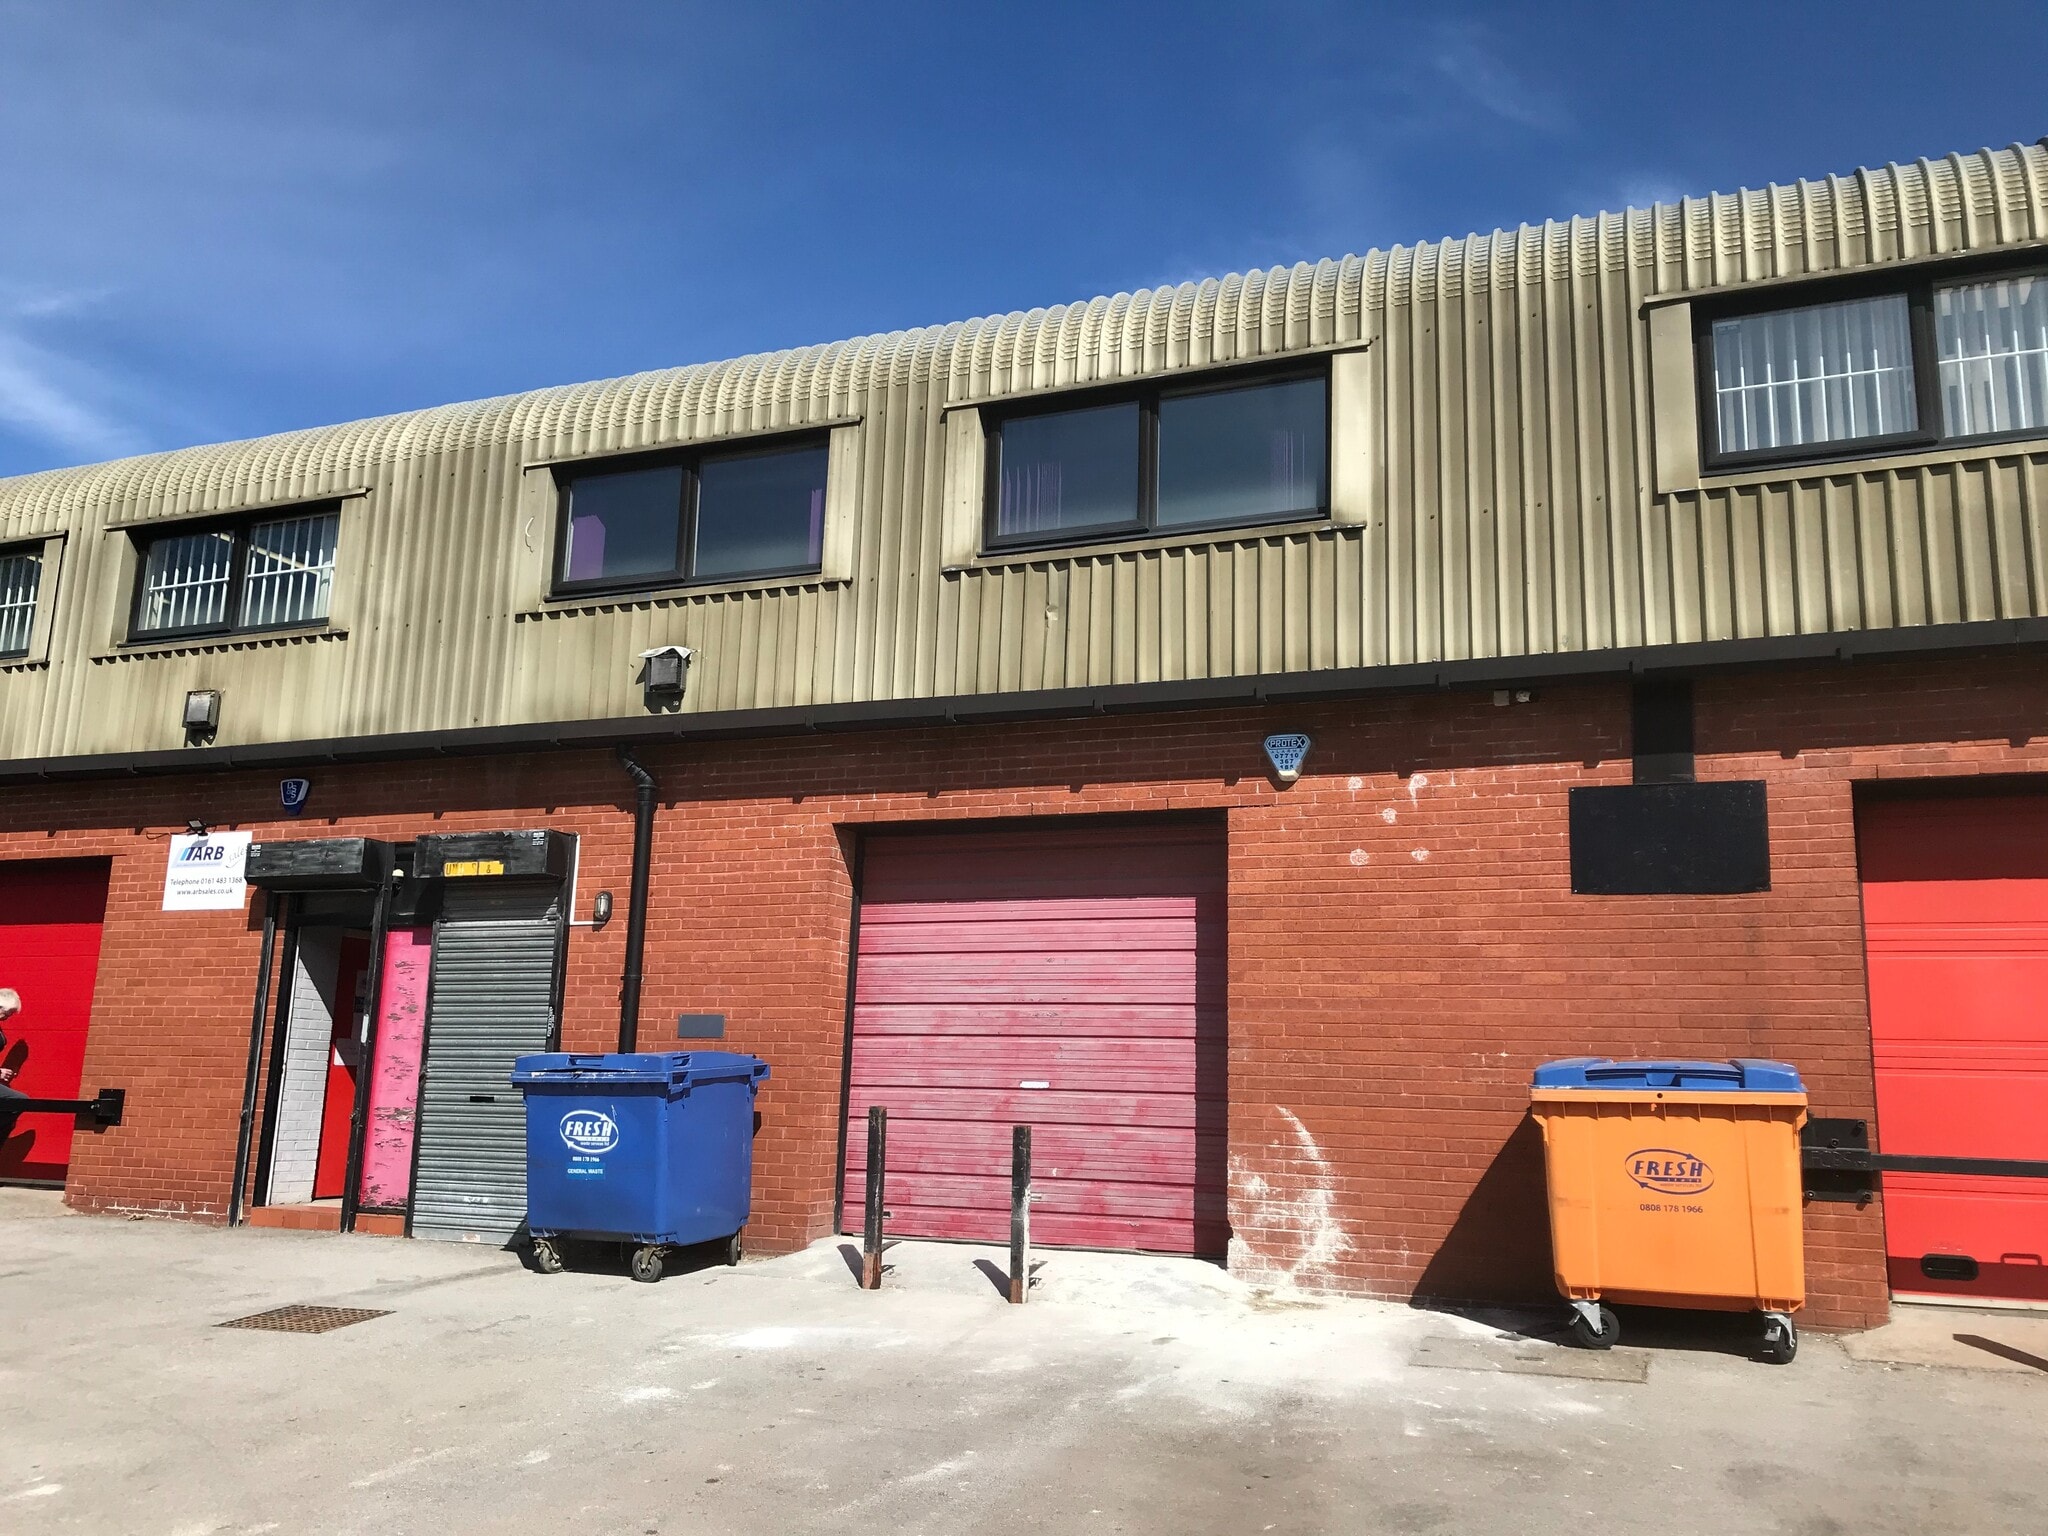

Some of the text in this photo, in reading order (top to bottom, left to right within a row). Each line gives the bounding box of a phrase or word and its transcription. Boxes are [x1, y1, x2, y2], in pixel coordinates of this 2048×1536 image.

[1270, 737, 1306, 748] PROTEX
[170, 878, 200, 887] Telephone
[228, 876, 243, 884] 1368
[176, 887, 233, 896] www.arbsales.co.uk
[564, 1120, 613, 1137] FRESH
[1634, 1160, 1704, 1177] FRESH
[1640, 1203, 1704, 1214] 0808 178 1966
